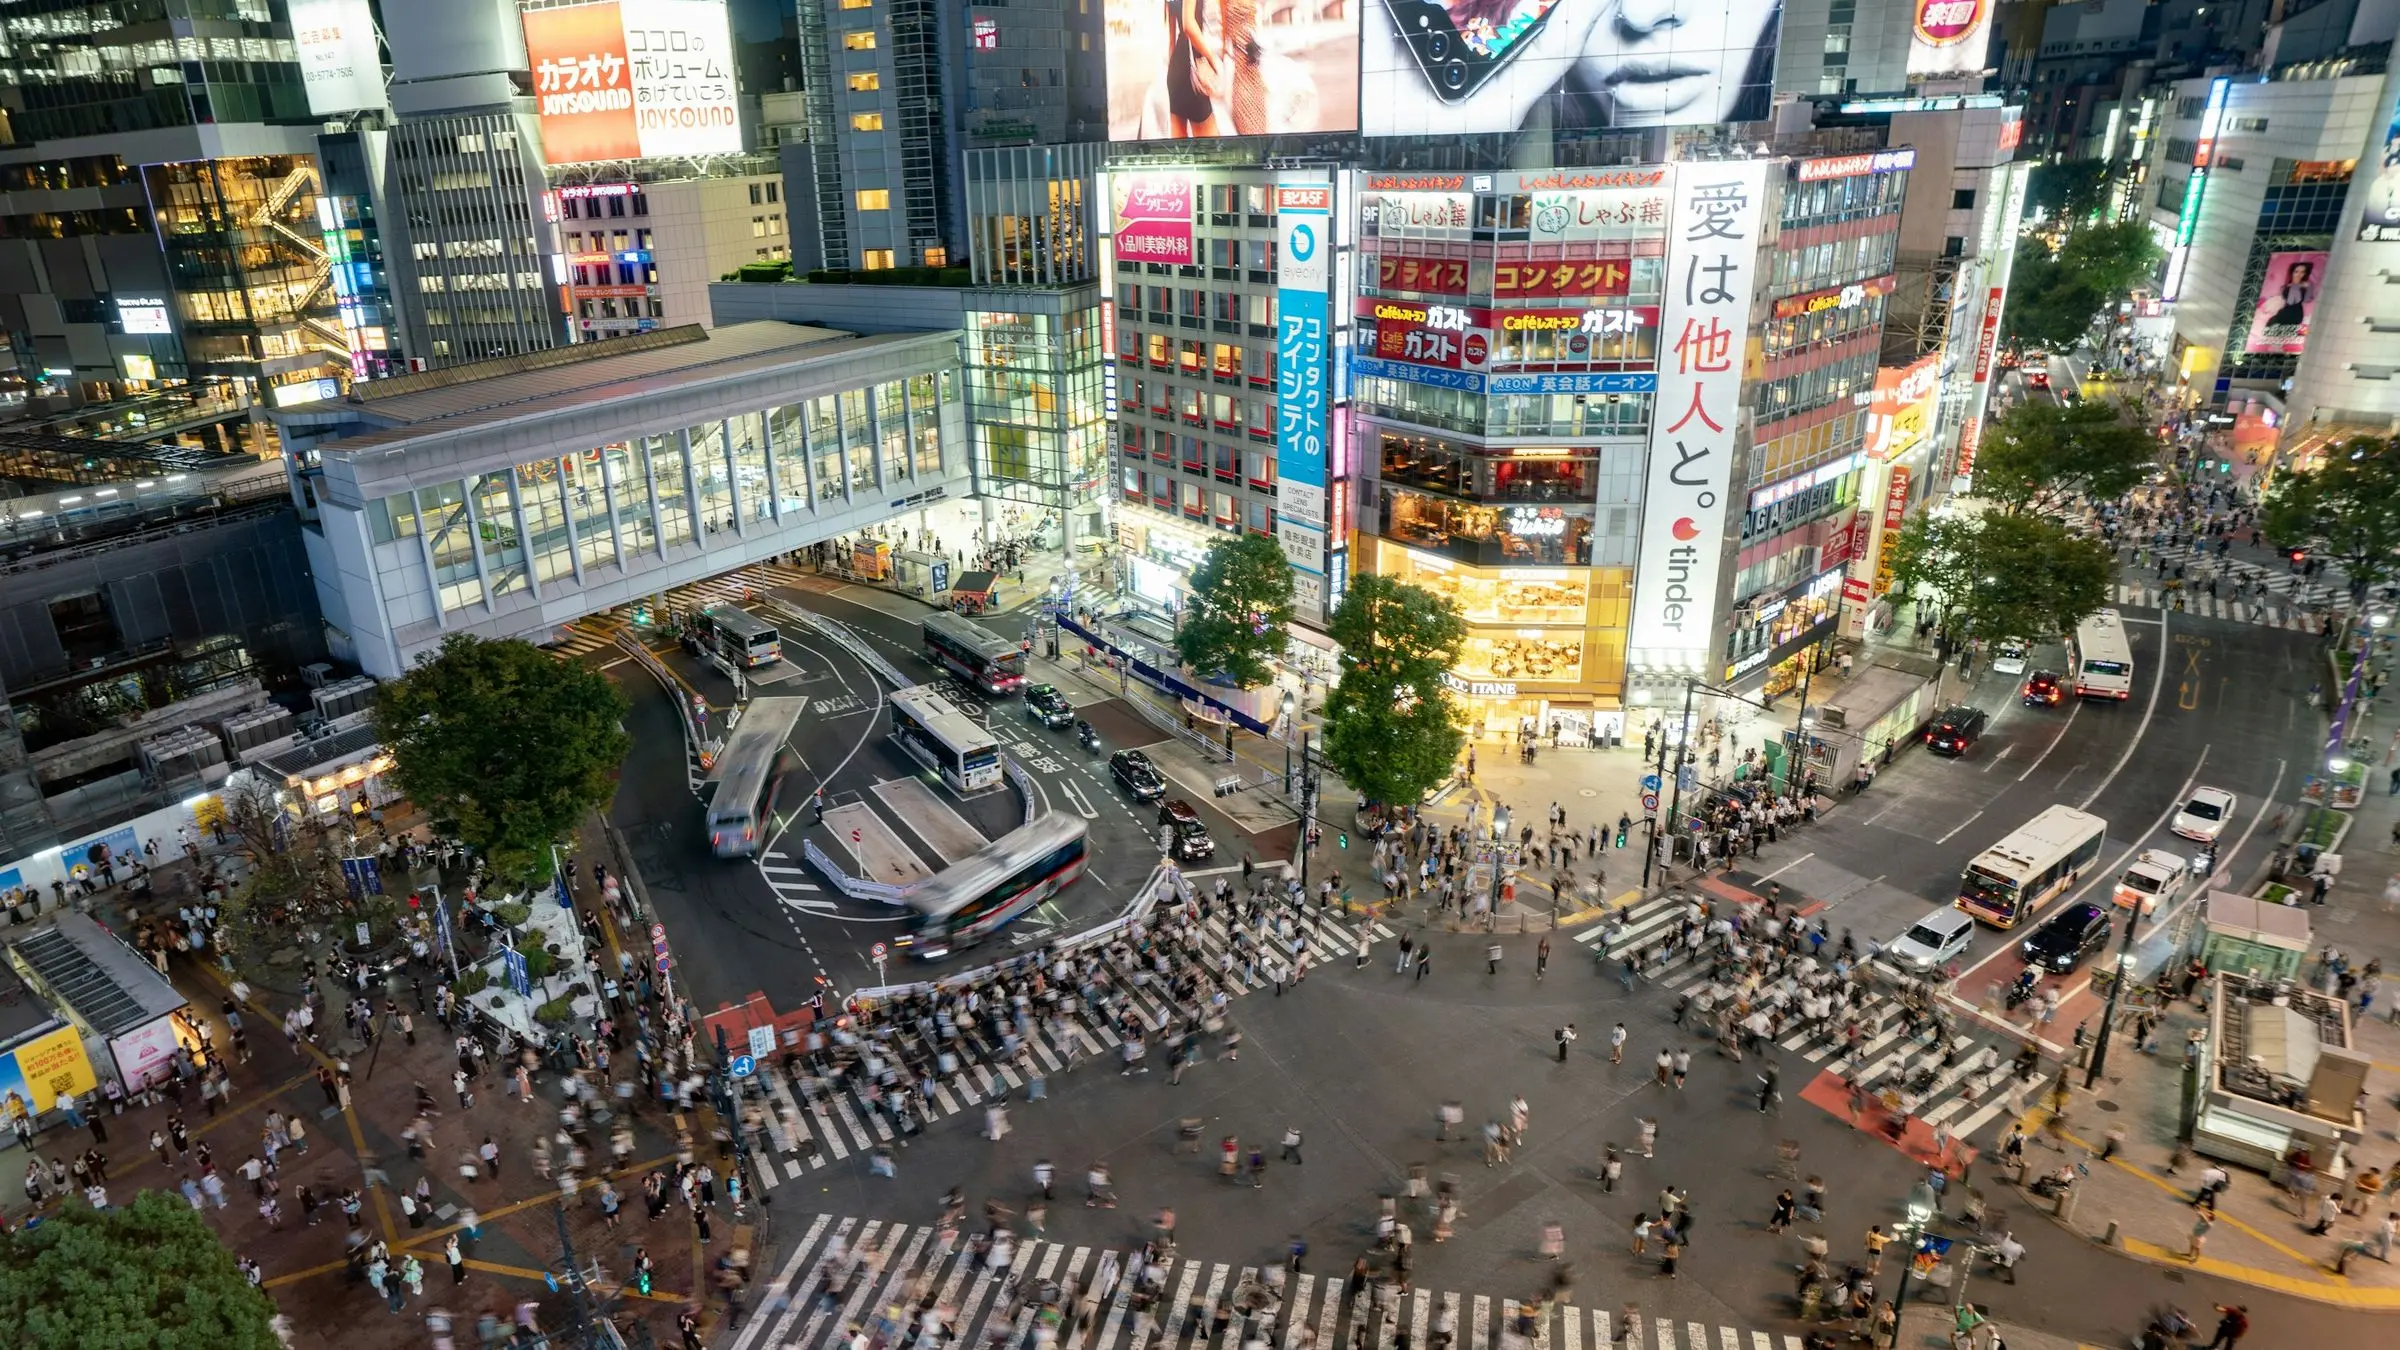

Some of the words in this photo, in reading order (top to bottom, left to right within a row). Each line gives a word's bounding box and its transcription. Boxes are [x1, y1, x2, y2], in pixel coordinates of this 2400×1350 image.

[630, 30, 705, 52] ココロの
[537, 53, 625, 92] カラオケ
[633, 56, 729, 80] ボリューム、
[543, 88, 631, 117] JOYSOUND
[637, 84, 733, 103] あげていこう。
[640, 106, 735, 130] JOYSOUND
[1367, 175, 1465, 190] しゃぶしゃぶバイキング
[1519, 171, 1665, 191] しゃぶしゃぶバイキング
[1362, 206, 1378, 222] 9F
[1411, 201, 1467, 227] しゃぶ葉
[1578, 197, 1665, 226] しゃぶ葉
[1125, 235, 1189, 256] 品川美容外科
[1283, 267, 1323, 284] eyecity
[1381, 260, 1466, 288] プライス
[1495, 263, 1627, 290] コンタクト
[1427, 305, 1472, 331] ガスト
[1581, 309, 1645, 334] ガスト
[1359, 328, 1378, 346] 7F
[1404, 331, 1458, 362] ガスト
[1667, 181, 1748, 509] 愛は他人と。
[1282, 315, 1304, 452] アイシティ
[1386, 363, 1462, 385] 英会話イーオン
[1496, 378, 1532, 391] AEON
[1541, 376, 1654, 392] 英会話イーオン
[1304, 317, 1320, 456] コンタクトの
[1287, 486, 1315, 500] CONTACT
[1662, 544, 1698, 633] tinder
